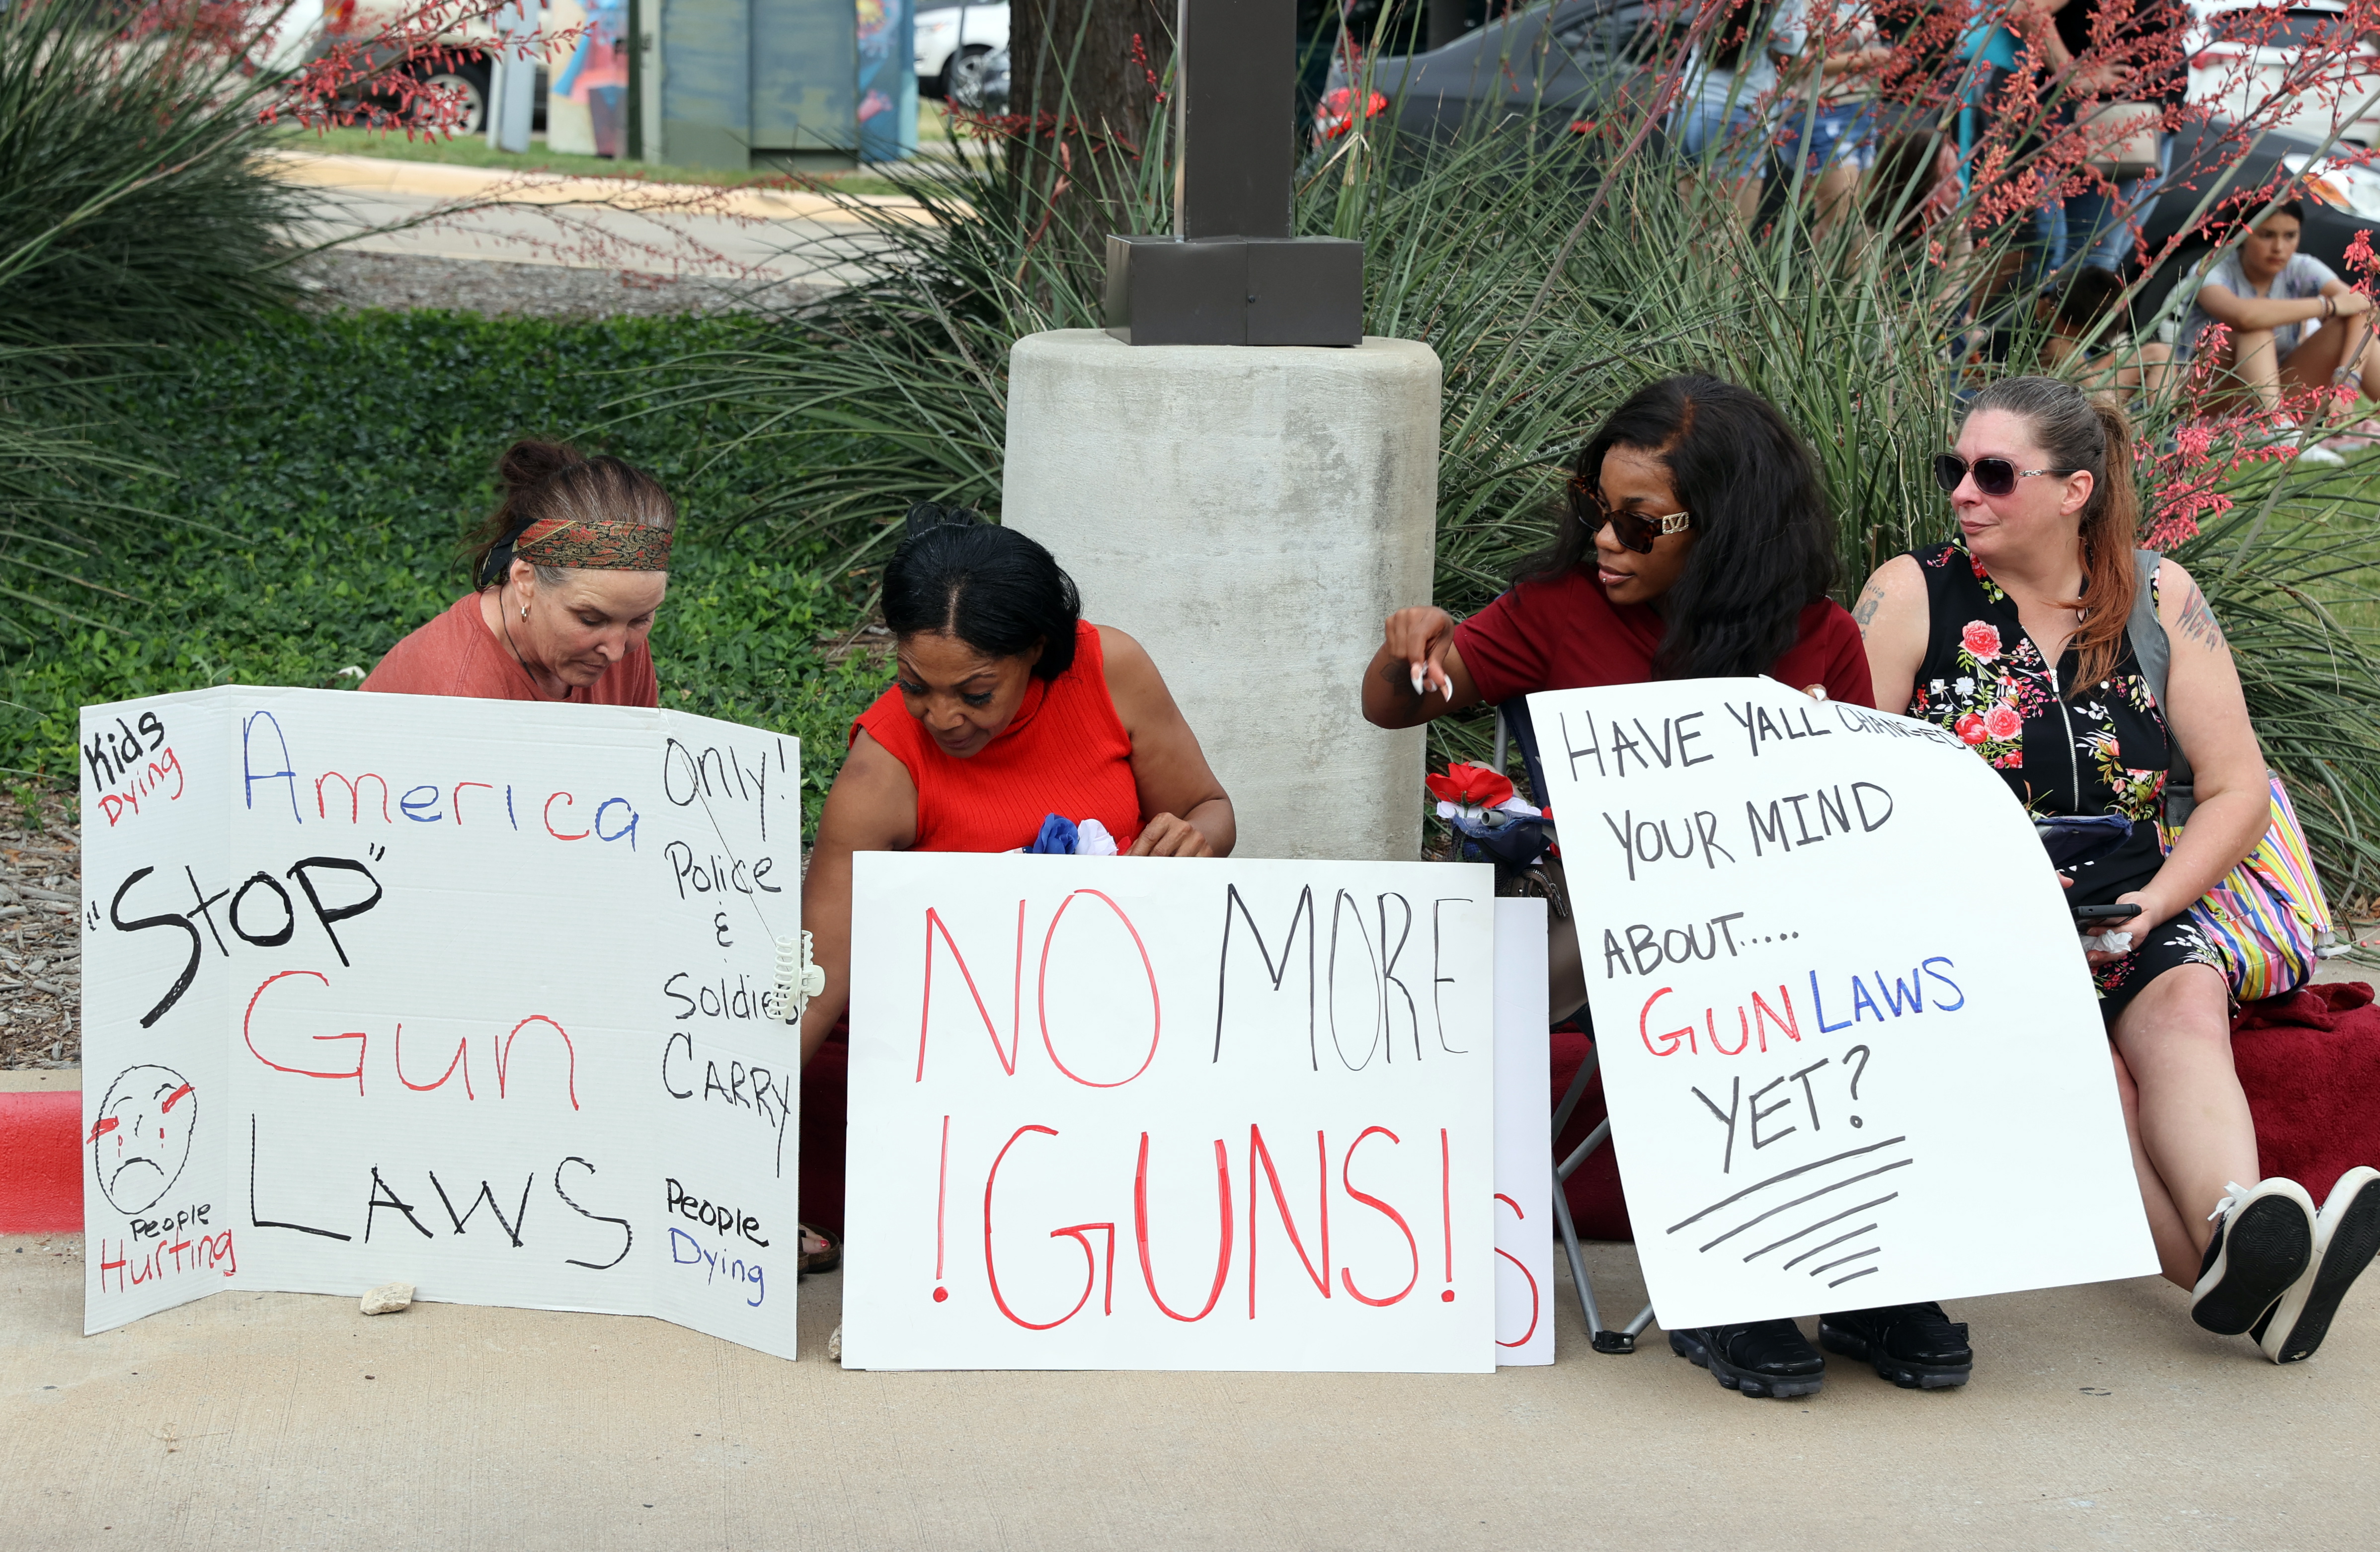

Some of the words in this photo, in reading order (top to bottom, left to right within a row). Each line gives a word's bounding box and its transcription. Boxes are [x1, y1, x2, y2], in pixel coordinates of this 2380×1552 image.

[83, 711, 164, 792] Kids
[243, 711, 638, 852] America
[1560, 710, 1714, 781] HAVE
[1724, 701, 1831, 757] YALL
[1834, 704, 1967, 750] CHANGED
[98, 747, 183, 827] Dying
[1602, 810, 1735, 881] YOUR
[1746, 782, 1893, 856] MIND
[664, 841, 782, 900] Police
[916, 887, 1160, 1088] NO
[1213, 883, 1473, 1072] MORE
[1640, 985, 1801, 1056] GUN
[1810, 956, 1964, 1033] LAWS
[244, 971, 578, 1111] Gun
[1691, 1044, 1870, 1173] YET?
[250, 1110, 633, 1270] LAWS
[666, 1177, 770, 1247] People
[100, 1227, 237, 1293] Hurting
[667, 1228, 766, 1307] Dying
